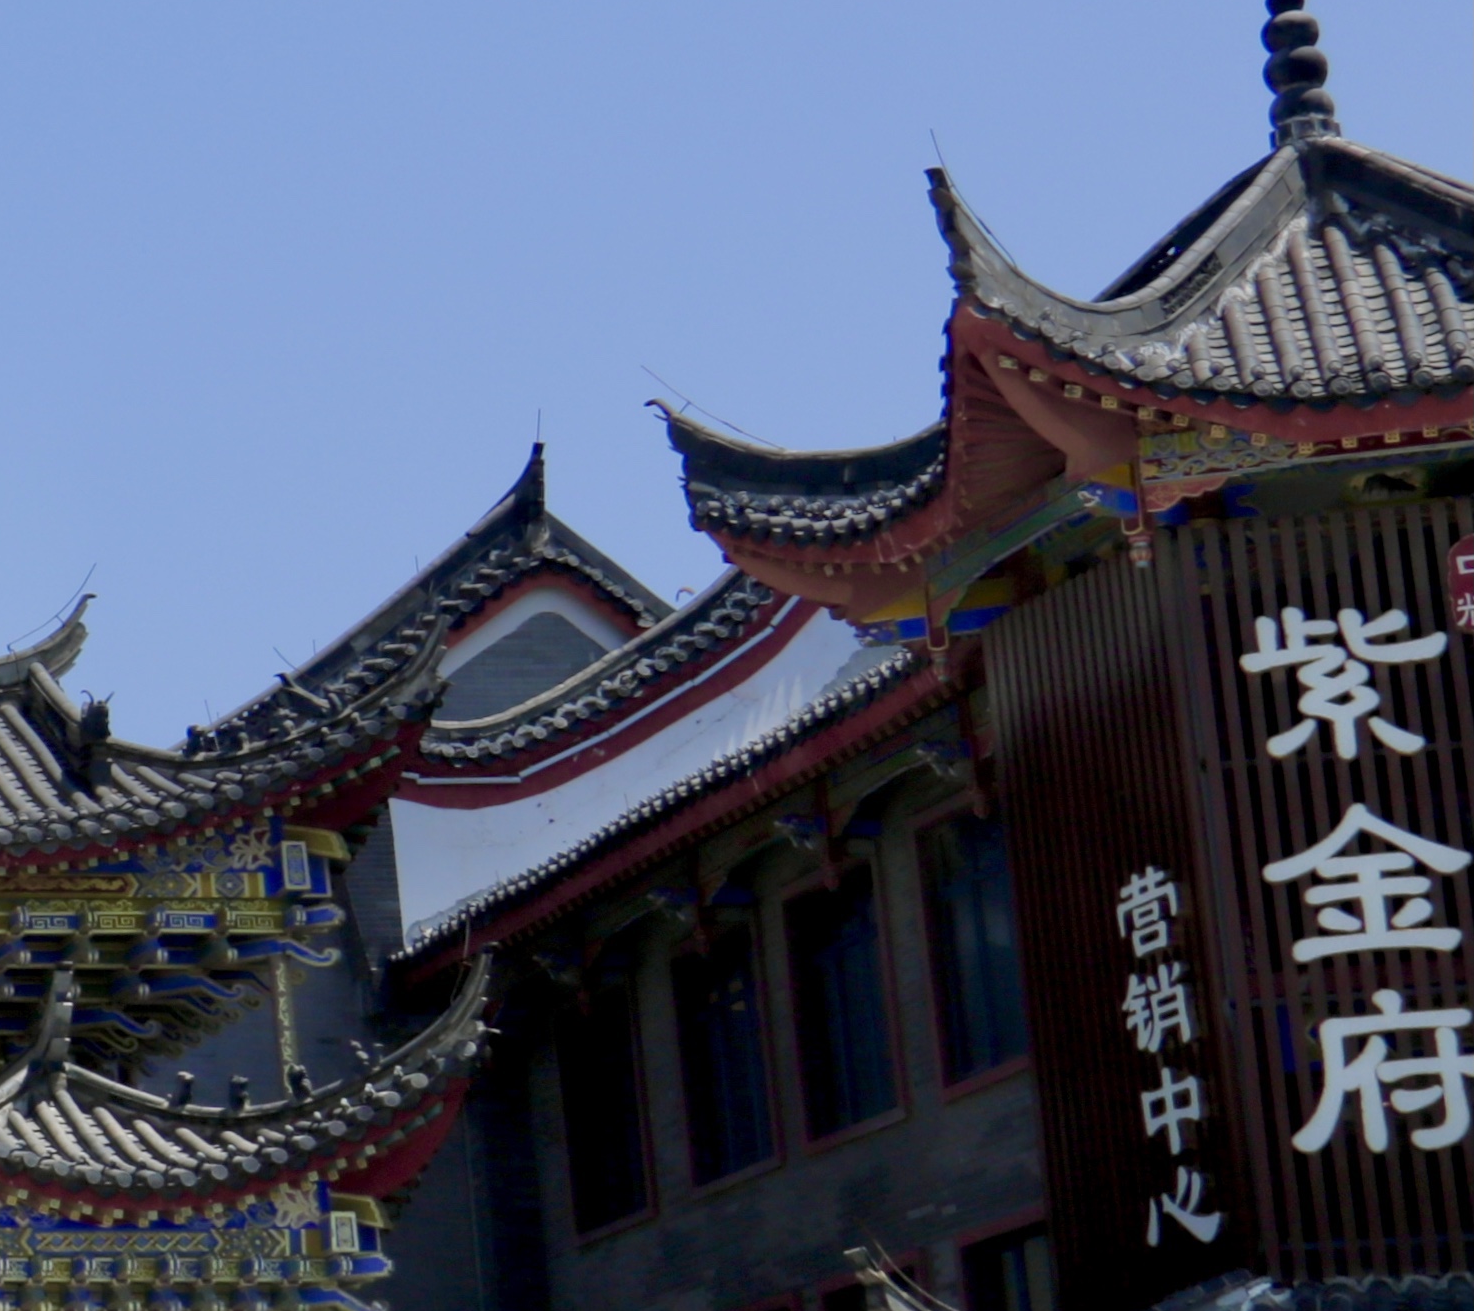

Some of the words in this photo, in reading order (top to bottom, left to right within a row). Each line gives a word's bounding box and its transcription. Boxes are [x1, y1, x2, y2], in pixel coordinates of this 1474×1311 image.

[1116, 864, 1226, 1248] 营销中心
[1240, 604, 1474, 1156] 紫金府
